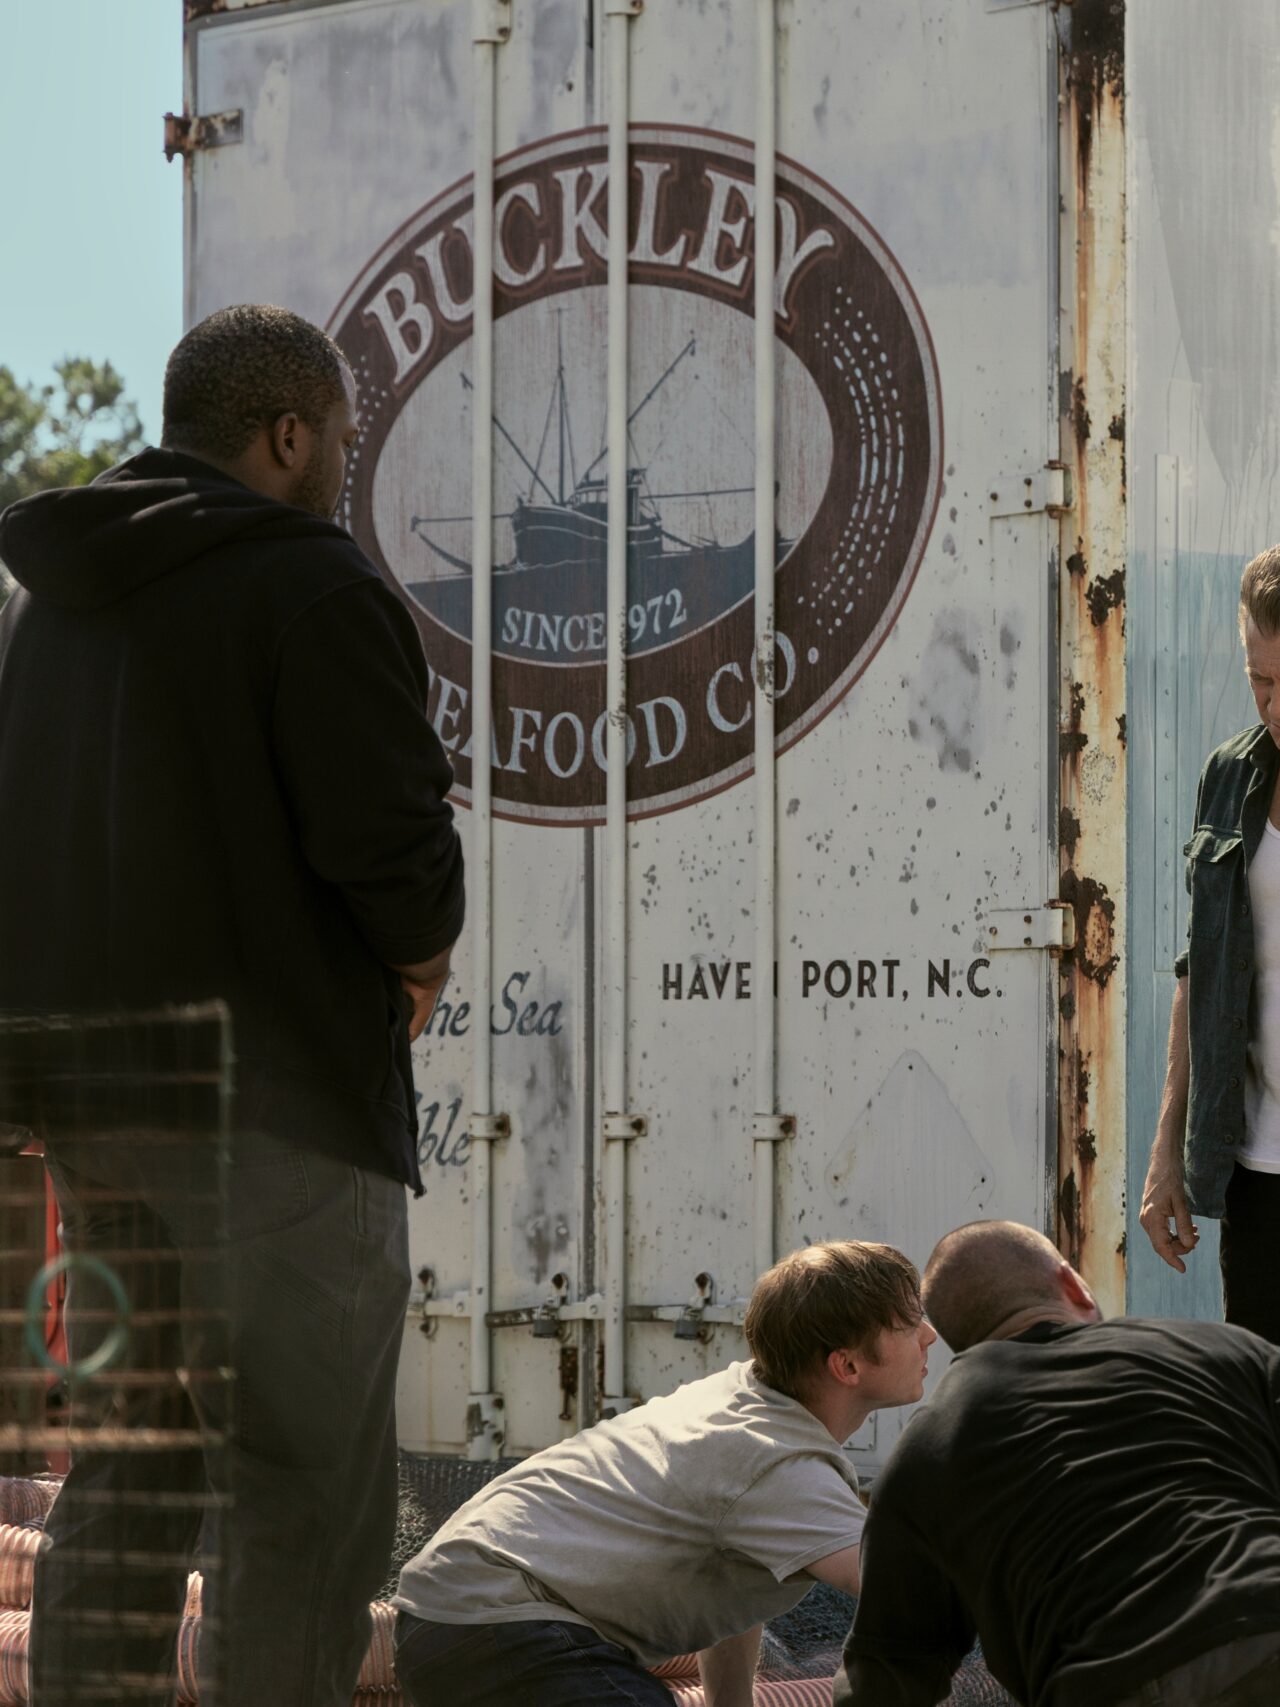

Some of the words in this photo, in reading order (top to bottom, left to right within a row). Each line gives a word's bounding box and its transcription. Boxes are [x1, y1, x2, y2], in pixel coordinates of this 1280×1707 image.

[364, 160, 835, 384] BUCKLEY
[502, 607, 606, 652] SINCE
[627, 588, 687, 642] 972
[428, 662, 687, 779] EAFOOD
[706, 631, 820, 733] CO.
[423, 979, 471, 1037] he
[489, 970, 564, 1037] Sea
[662, 961, 777, 1001] HAVE
[802, 959, 909, 1001] PORT,
[927, 957, 1003, 999] N.C.
[413, 1089, 472, 1167] ble
